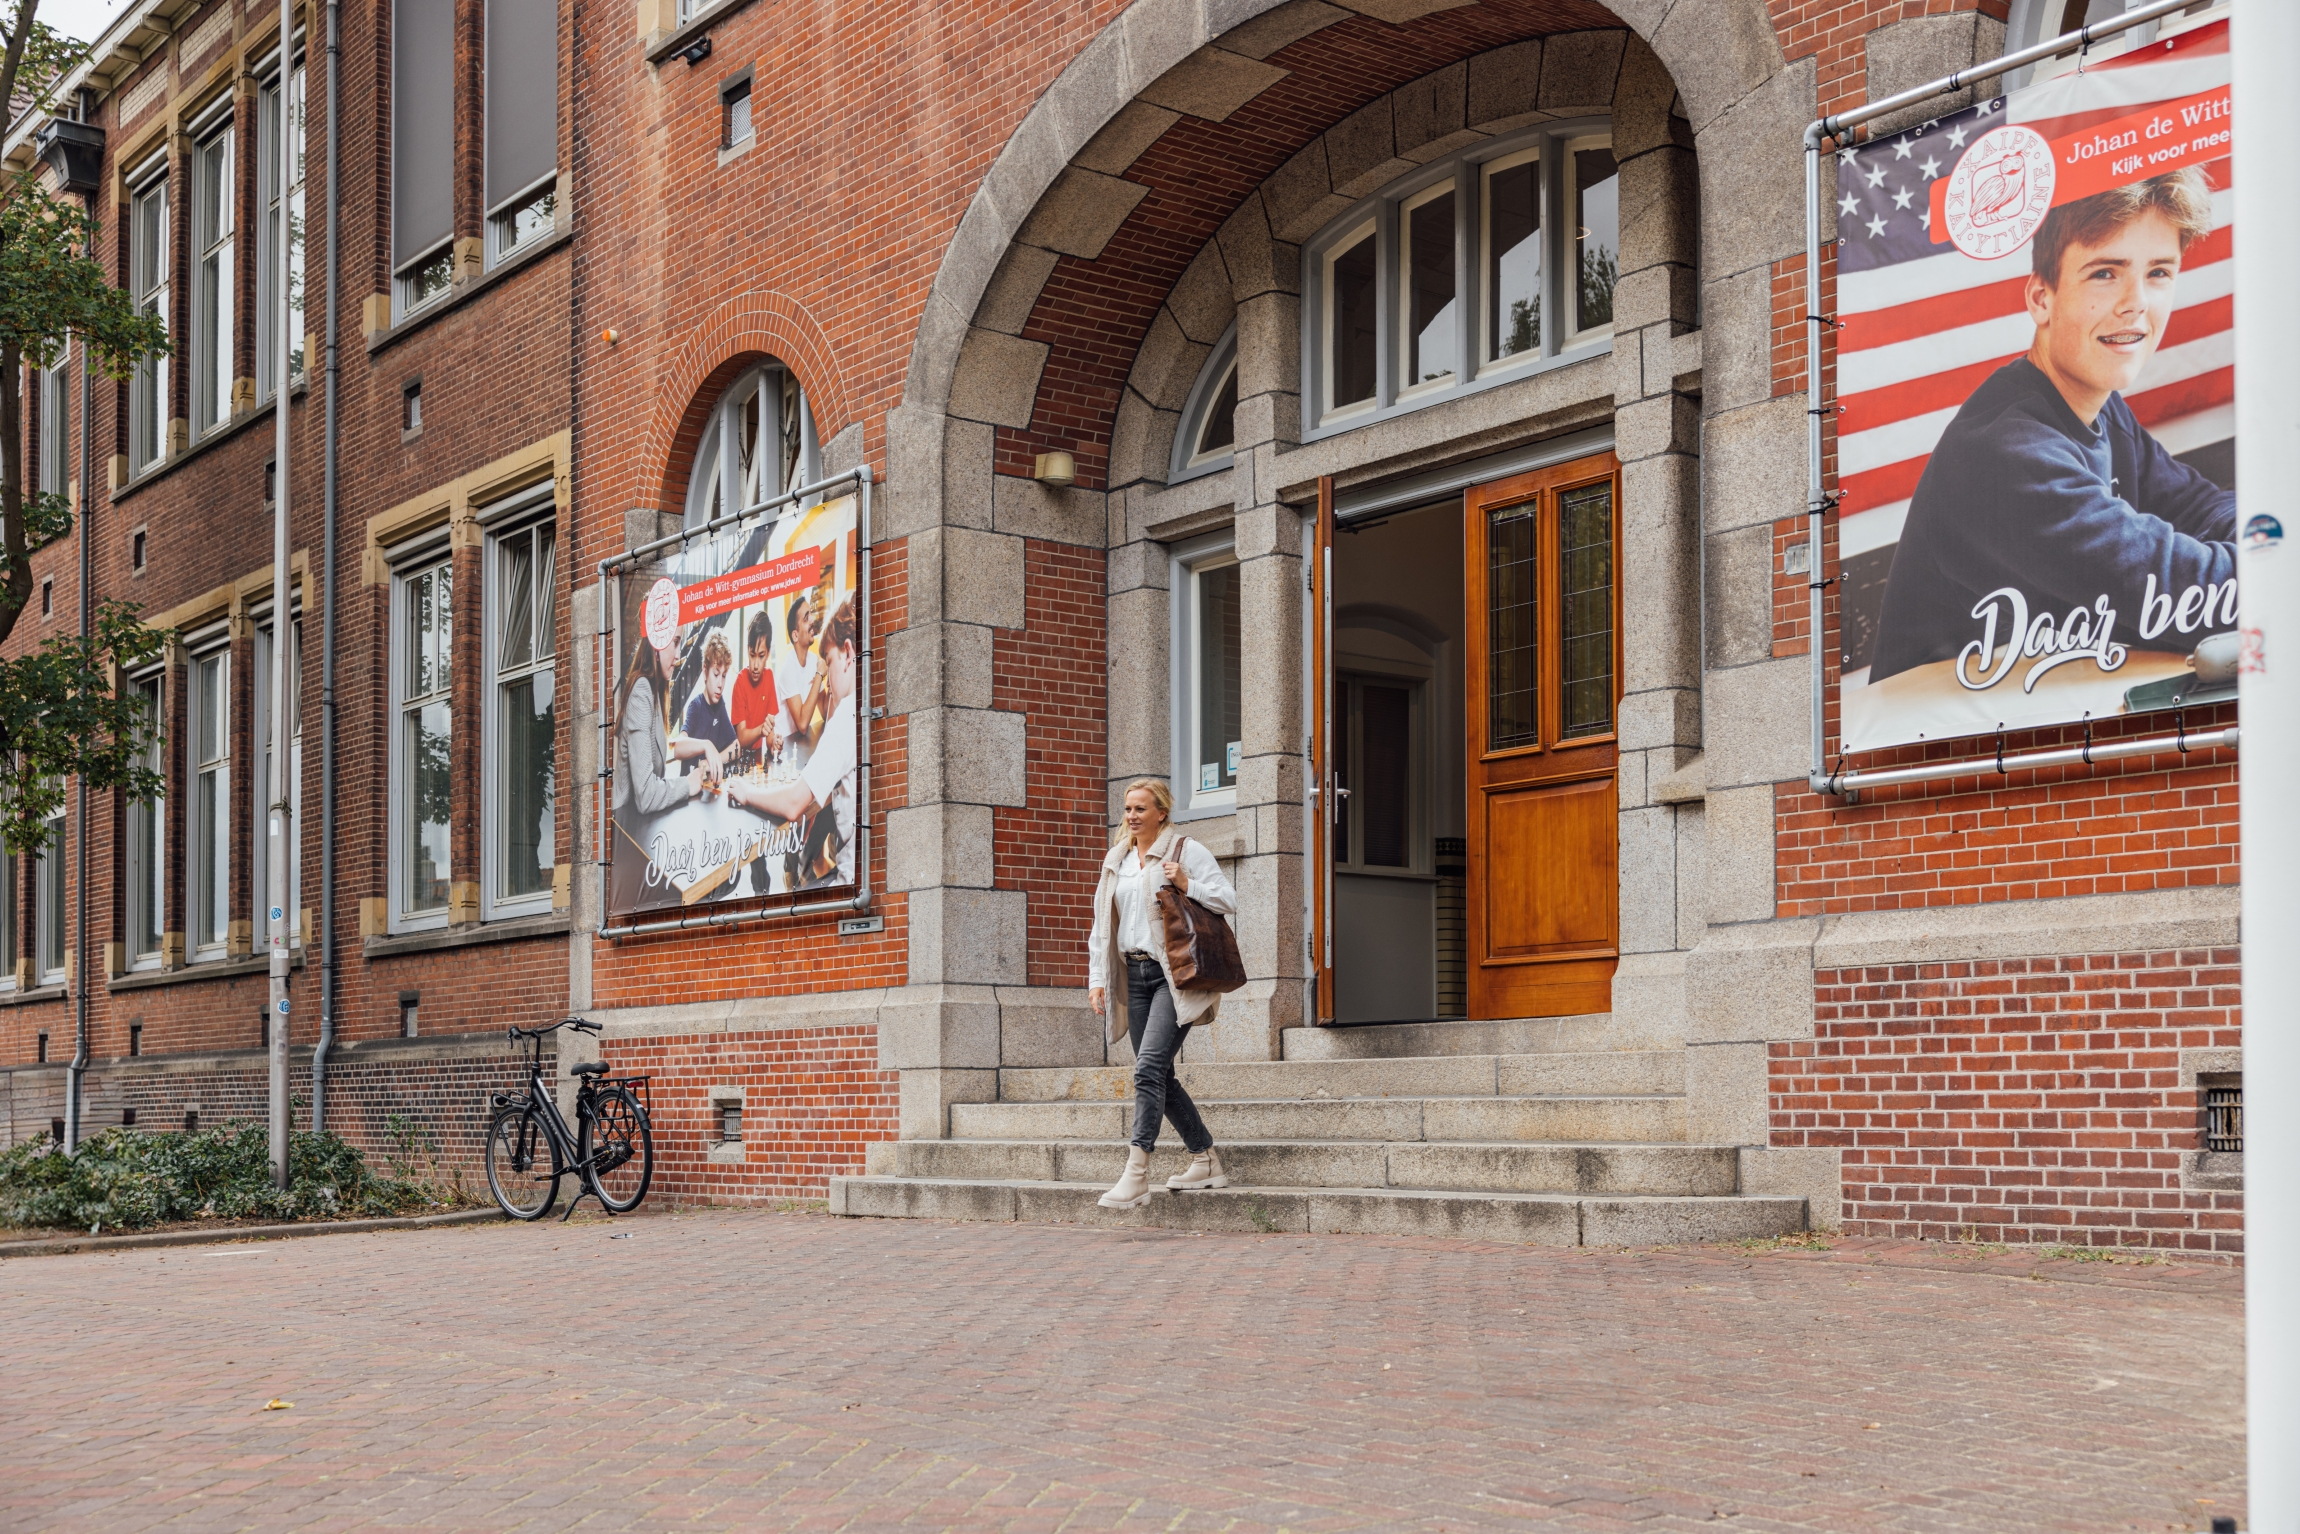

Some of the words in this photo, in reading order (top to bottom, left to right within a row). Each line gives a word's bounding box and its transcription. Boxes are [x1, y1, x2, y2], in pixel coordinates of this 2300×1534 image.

[2066, 129, 2138, 164] Johan
[2145, 116, 2174, 139] de
[2112, 154, 2144, 176] Kijk
[2148, 142, 2188, 164] voor
[2192, 130, 2232, 151] mee
[682, 590, 704, 604] Johan
[705, 585, 714, 597] de
[715, 569, 774, 594] Witt-gymnasium
[776, 554, 815, 576] Dordrecht
[695, 604, 705, 615] Kijk
[706, 602, 718, 610] voor
[718, 597, 732, 607] meer
[733, 588, 760, 603] informatie
[761, 586, 769, 595] op:
[1956, 587, 2127, 693] Daar
[2139, 573, 2239, 640] ben
[645, 831, 697, 890] Daar
[700, 830, 732, 868] ben
[729, 828, 753, 885] je
[755, 814, 806, 858] thuis!
